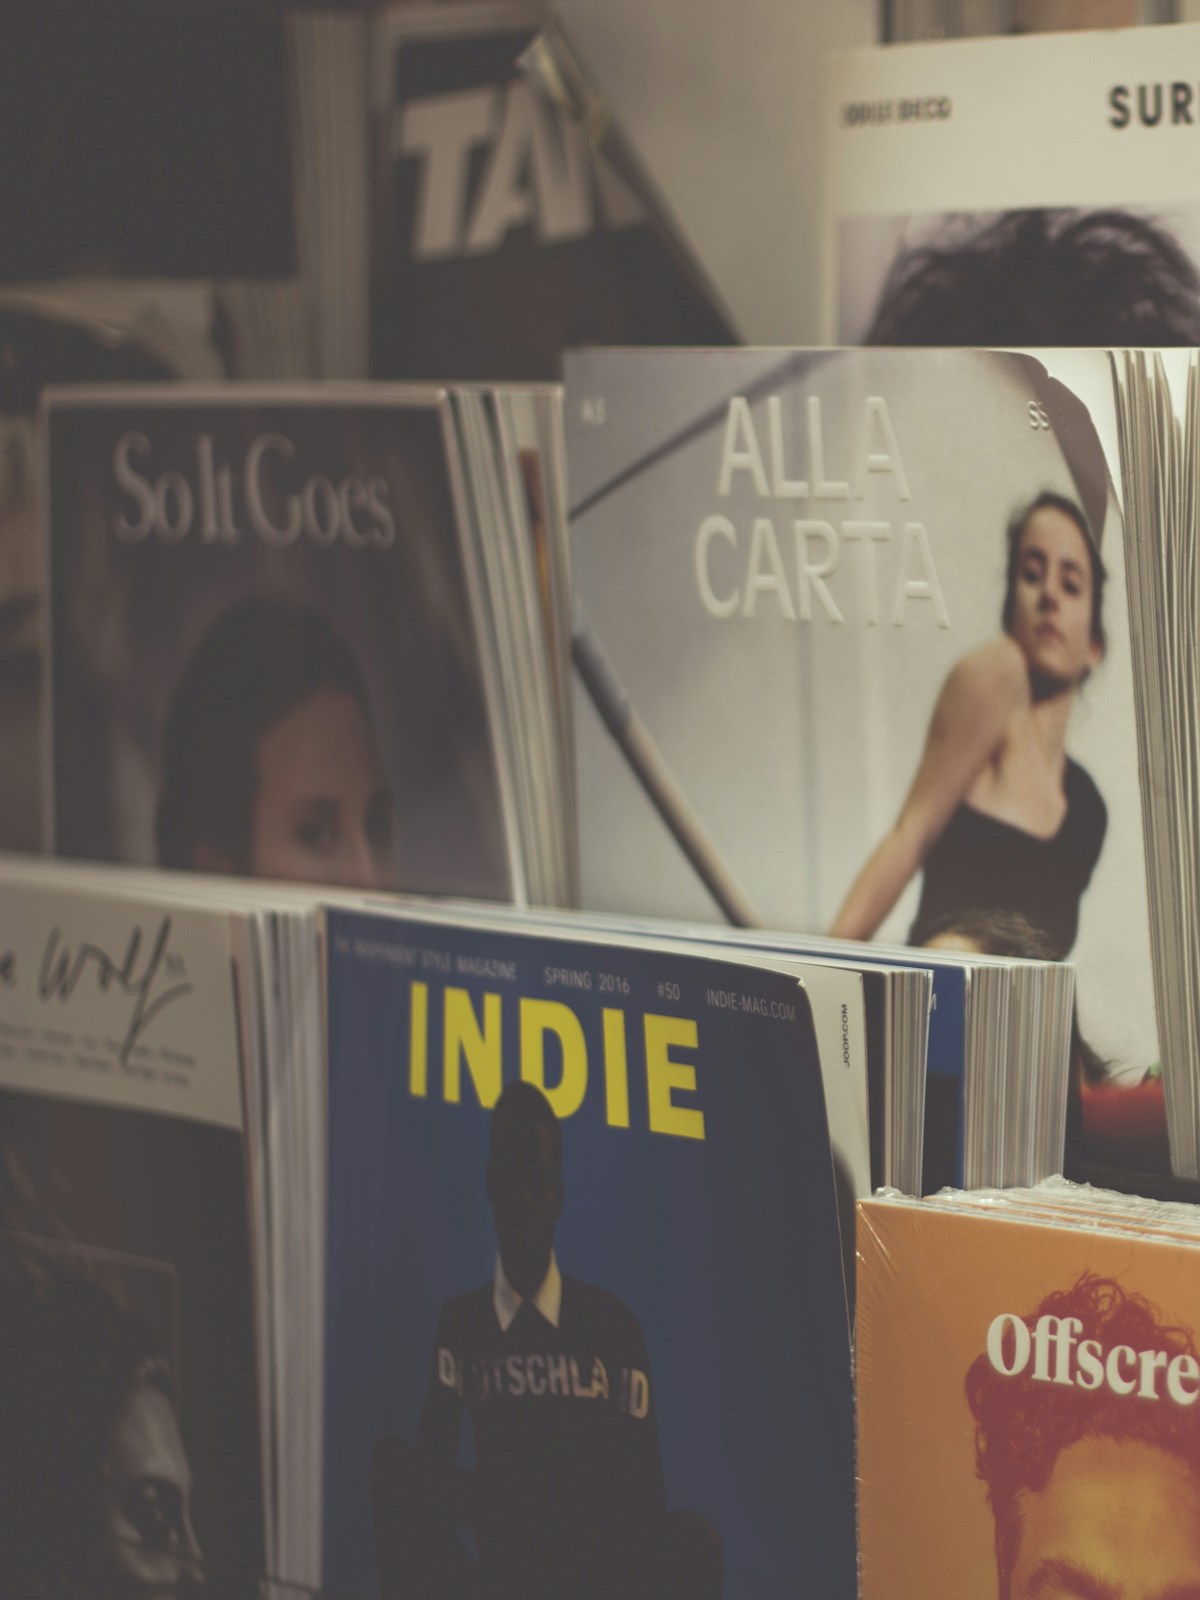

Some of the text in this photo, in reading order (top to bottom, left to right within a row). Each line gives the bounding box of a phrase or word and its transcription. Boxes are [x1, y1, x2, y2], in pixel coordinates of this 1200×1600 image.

[718, 396, 911, 502] ALLA
[113, 430, 397, 550] So It Goes
[695, 514, 951, 629] CARTA
[456, 954, 518, 982] MAGAZINE
[544, 965, 631, 995] SPRING 2016
[656, 981, 682, 1002] #50
[705, 987, 798, 1023] INDIE-MAG.COM
[841, 1002, 850, 1068] JOOP.COM
[410, 979, 706, 1141] INDIE
